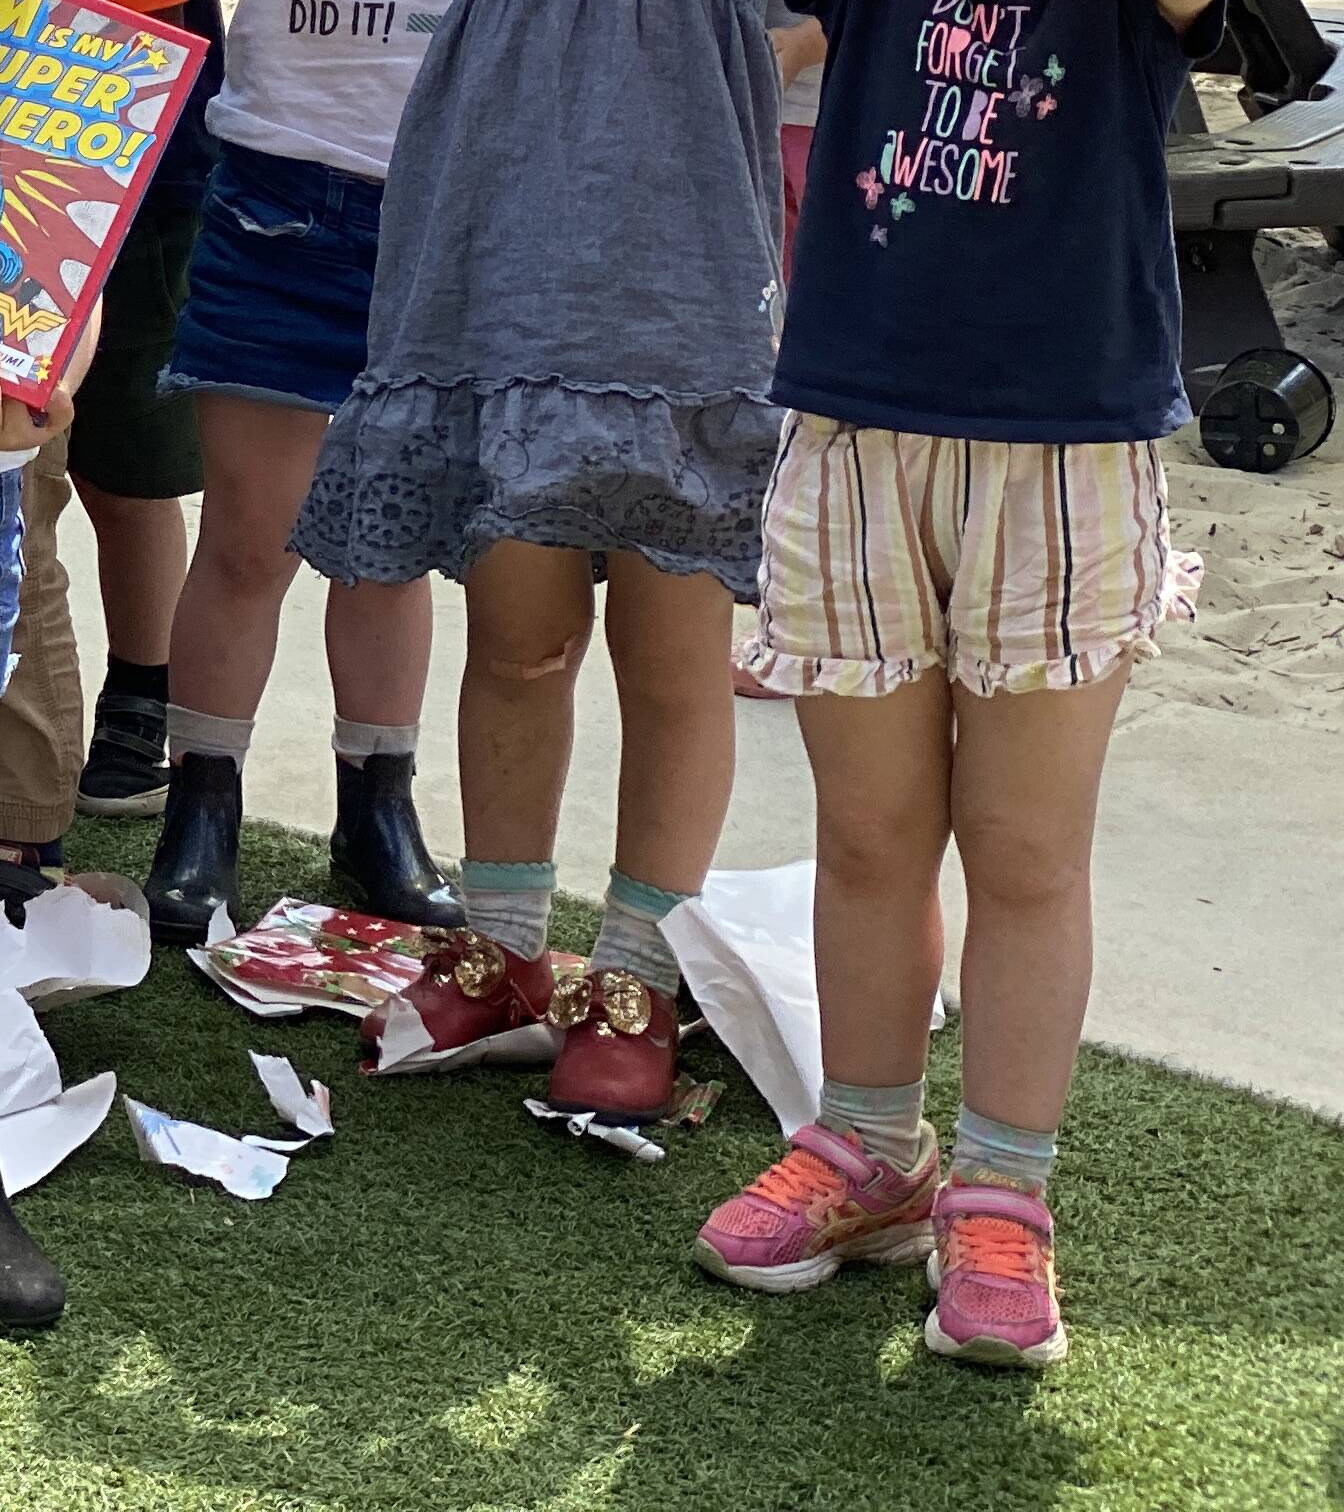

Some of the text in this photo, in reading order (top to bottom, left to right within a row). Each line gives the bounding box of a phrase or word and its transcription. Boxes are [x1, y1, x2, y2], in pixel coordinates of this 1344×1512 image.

[39, 23, 67, 48] IS
[76, 36, 124, 64] MY
[289, 0, 396, 44] DID IT!
[915, 20, 1027, 88] FORGET
[921, 79, 1004, 145] TO BE
